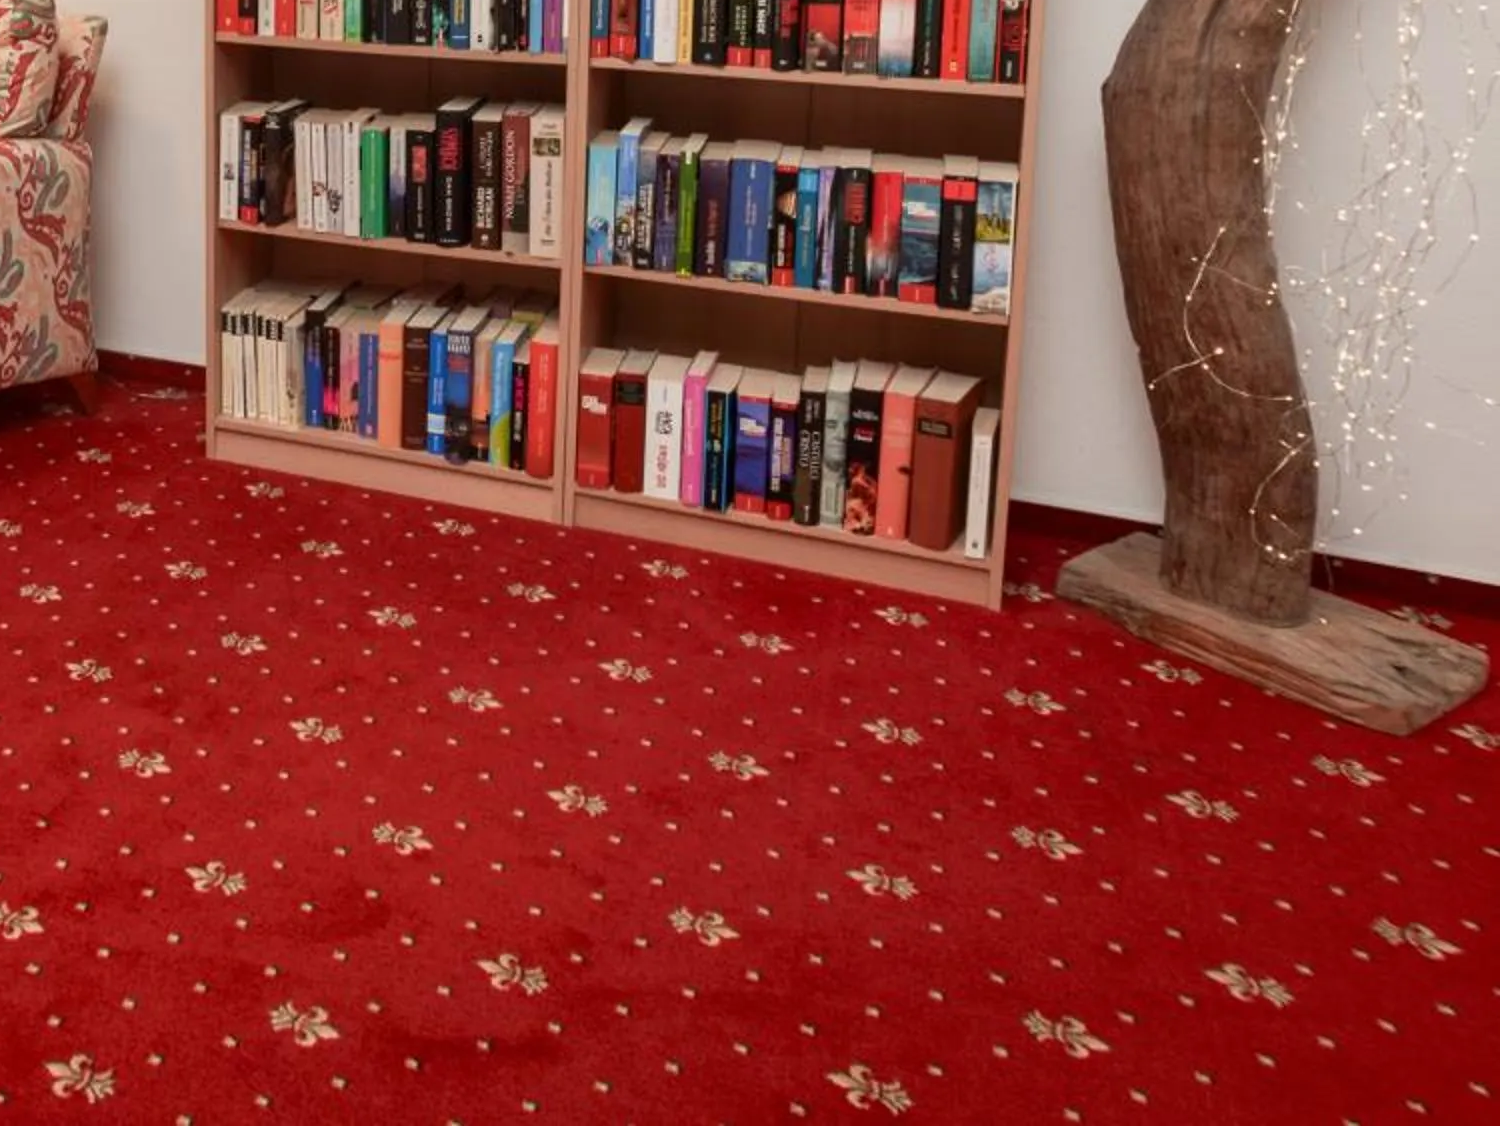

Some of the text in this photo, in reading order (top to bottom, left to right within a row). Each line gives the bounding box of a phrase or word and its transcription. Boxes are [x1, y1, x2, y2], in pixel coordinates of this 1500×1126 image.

[756, 9, 766, 35] JOHN
[504, 129, 516, 220] NOAH GORDON
